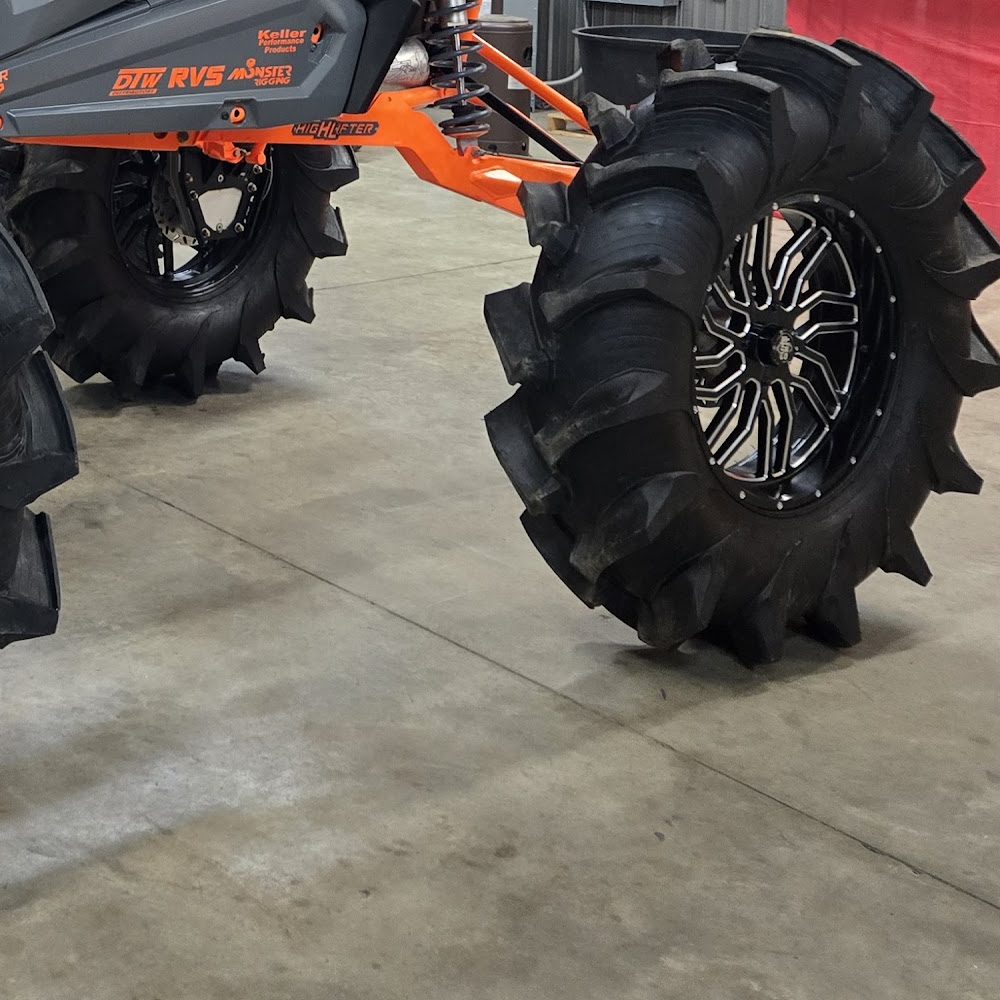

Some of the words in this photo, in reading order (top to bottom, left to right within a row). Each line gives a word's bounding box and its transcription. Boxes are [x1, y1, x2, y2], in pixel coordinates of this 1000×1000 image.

[258, 29, 307, 40] Keller
[258, 38, 305, 46] Performance
[264, 45, 297, 54] Products
[112, 67, 167, 90] DTW
[168, 65, 226, 89] RVS
[227, 58, 293, 81] MONSTER
